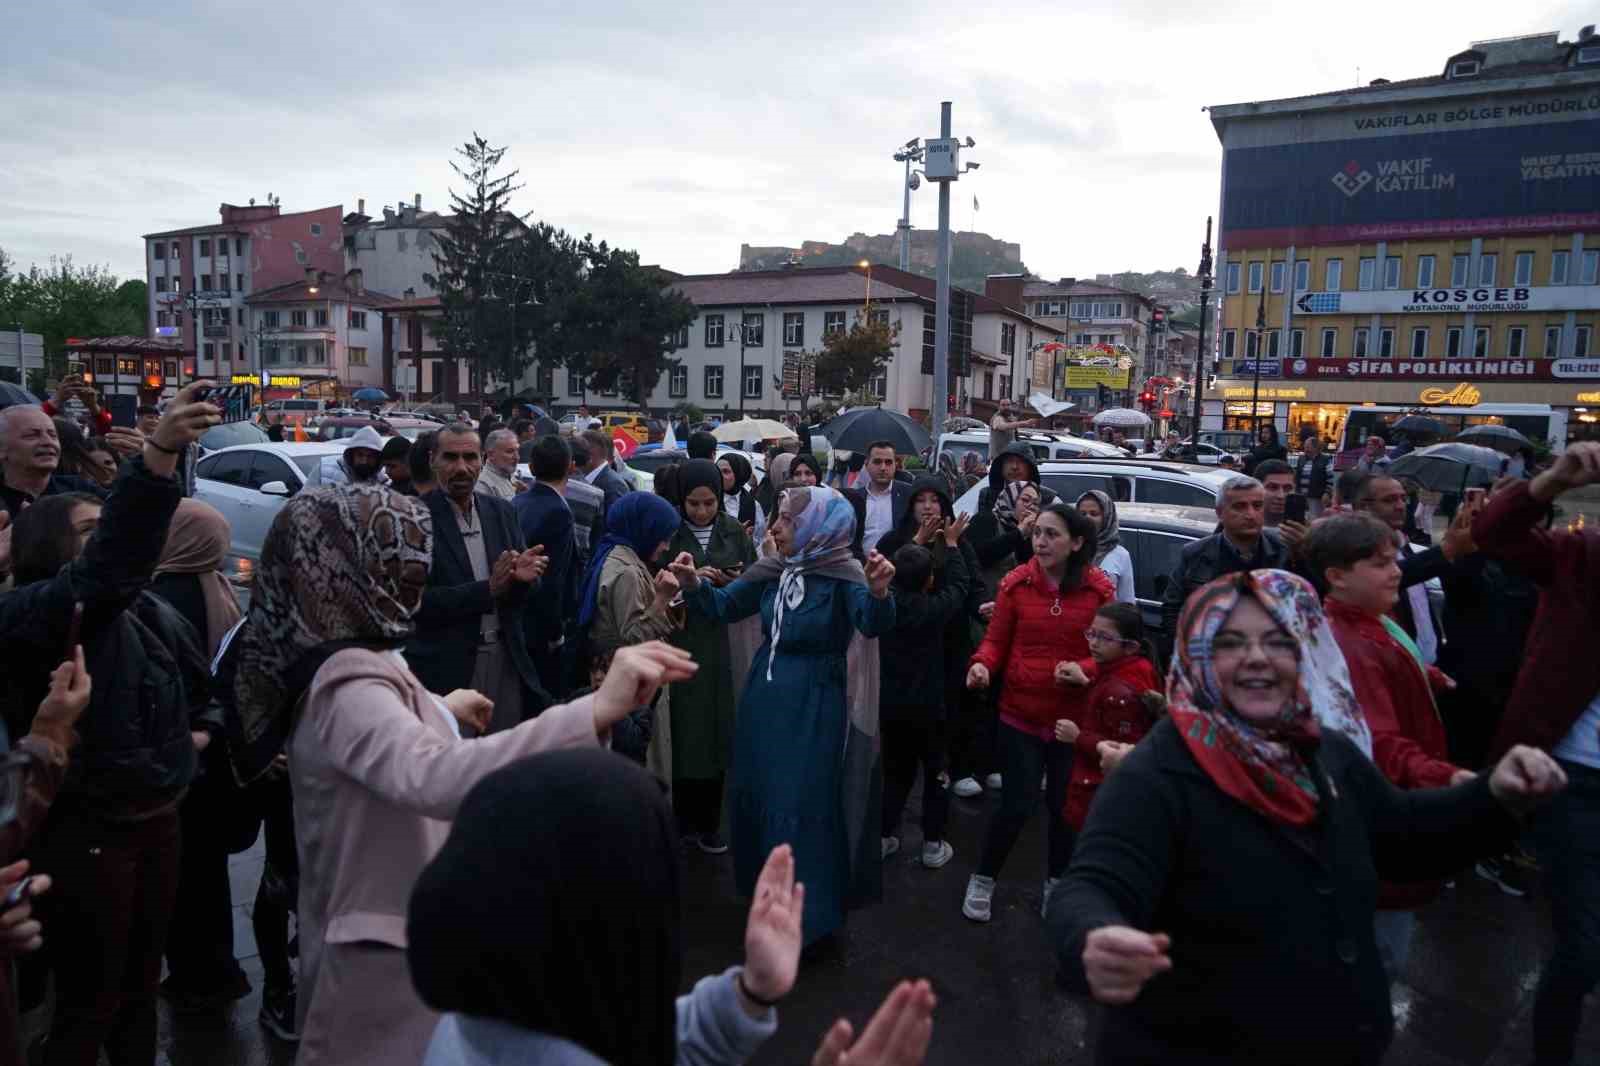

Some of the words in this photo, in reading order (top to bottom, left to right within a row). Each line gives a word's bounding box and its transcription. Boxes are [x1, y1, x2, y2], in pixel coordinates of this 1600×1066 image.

[1354, 112, 1437, 131] VAKIFLAR
[1444, 106, 1504, 123] BÖLGE
[1377, 157, 1432, 176] VAKIF
[1376, 173, 1456, 193] KATILIM
[1412, 287, 1531, 304] KOSGEB
[1346, 359, 1394, 375] ŞİFA
[1398, 359, 1536, 375] POLİKLİNİĞİ
